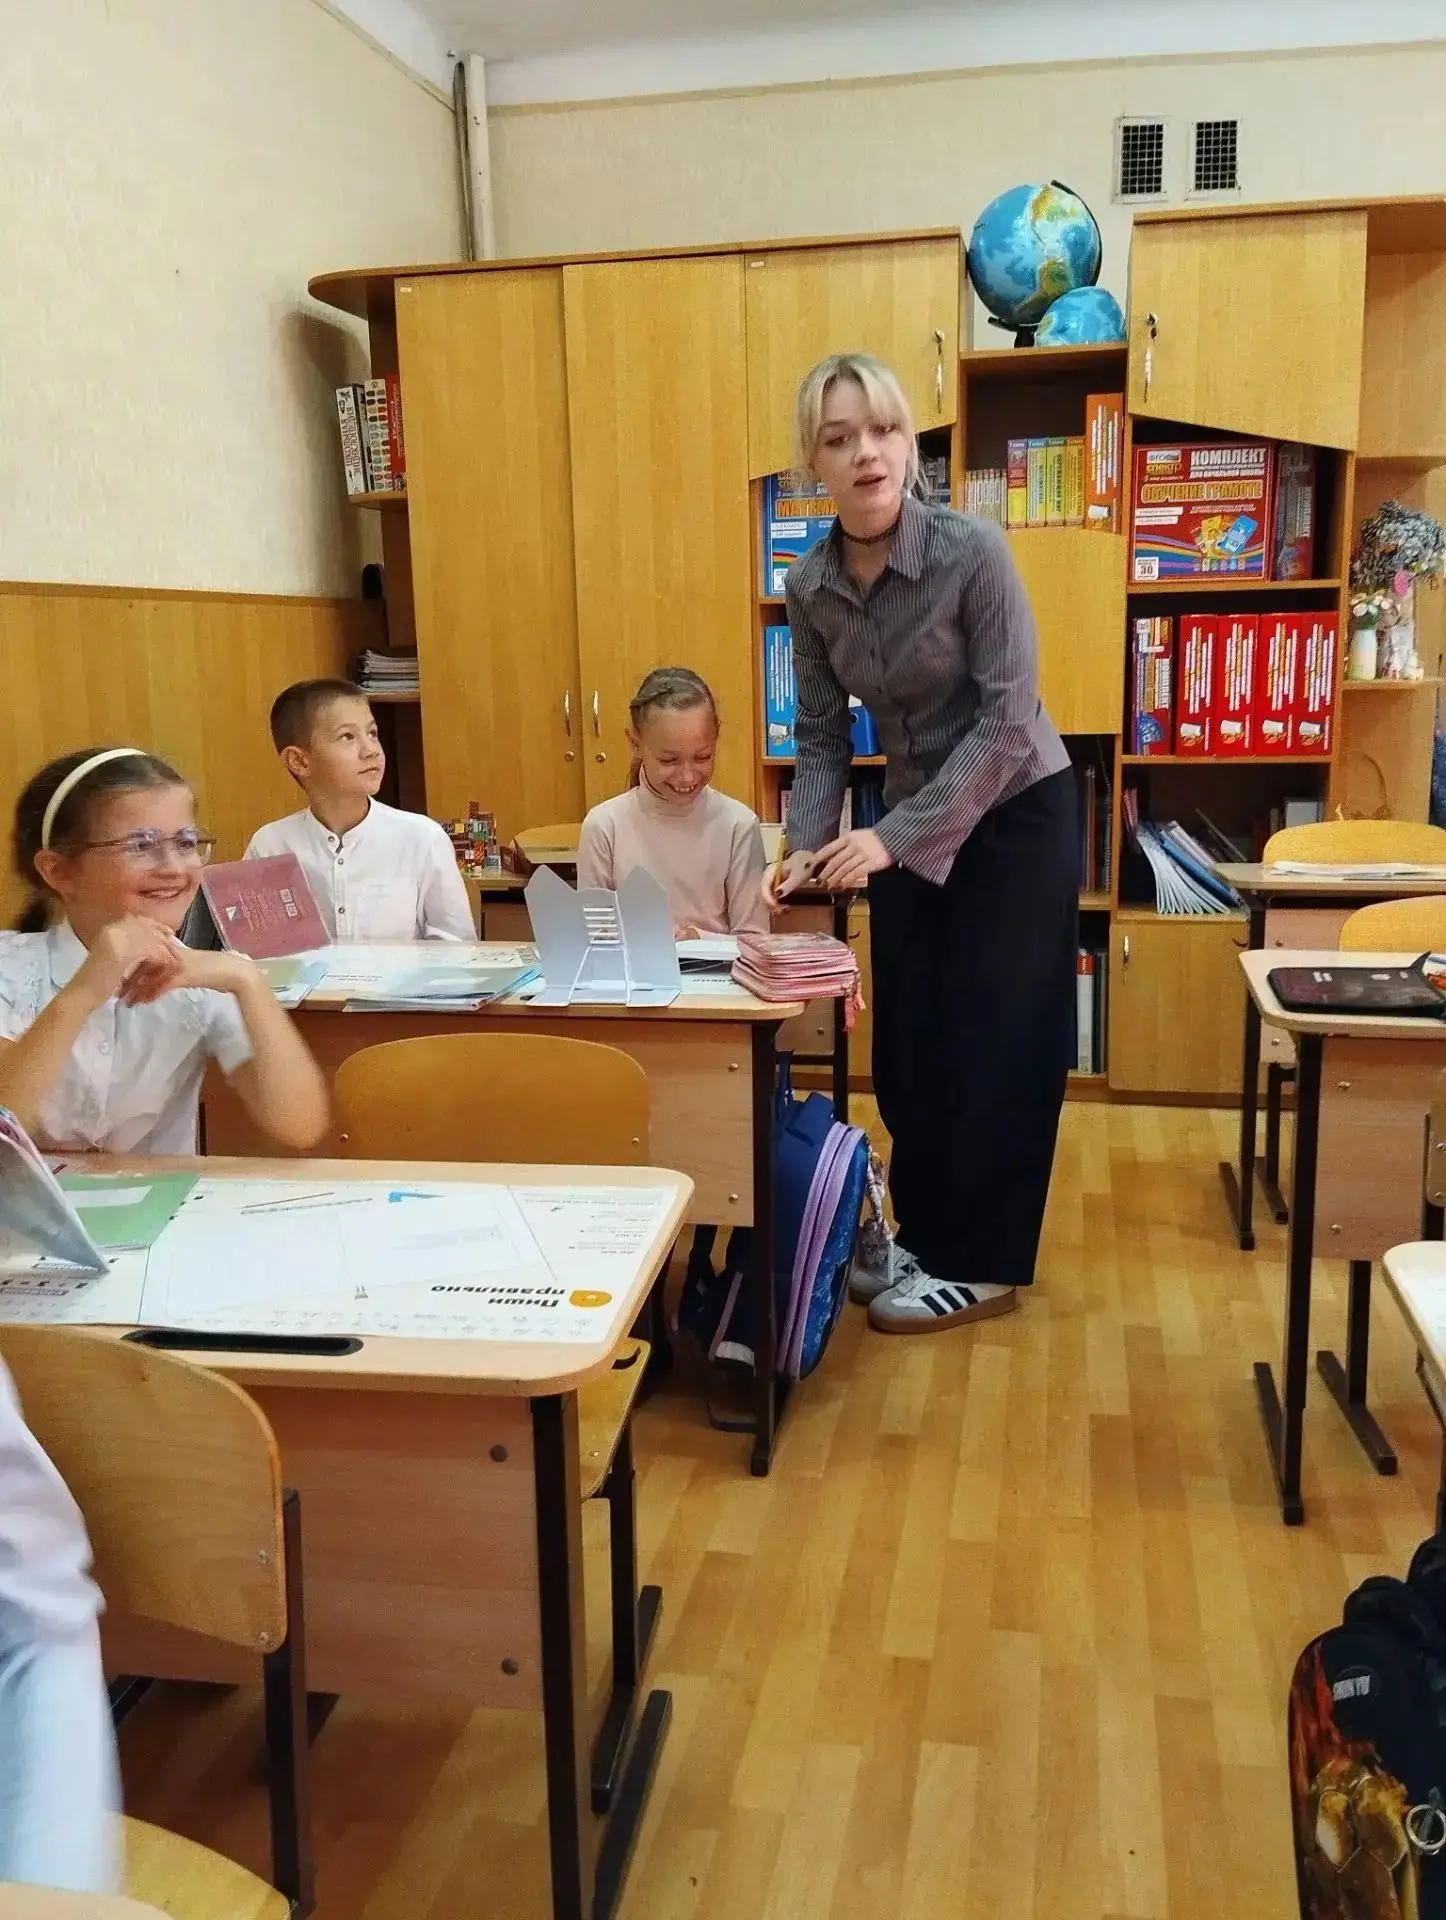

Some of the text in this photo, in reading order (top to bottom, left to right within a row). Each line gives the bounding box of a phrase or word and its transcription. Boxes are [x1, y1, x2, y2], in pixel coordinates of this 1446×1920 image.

[341, 419, 352, 467] ШКОЛЬНАЯ
[346, 407, 362, 476] ЭНЦИКЛОПЕДИЯ
[1191, 448, 1266, 465] КОМПЛЕКТ
[1142, 480, 1262, 502] ОБУЧЕНИЕ ГРАМОТЕ
[776, 499, 838, 517] МАТЕМА
[1140, 565, 1153, 574] 30
[430, 1285, 566, 1295] правильно
[488, 1298, 559, 1307] Пиши
